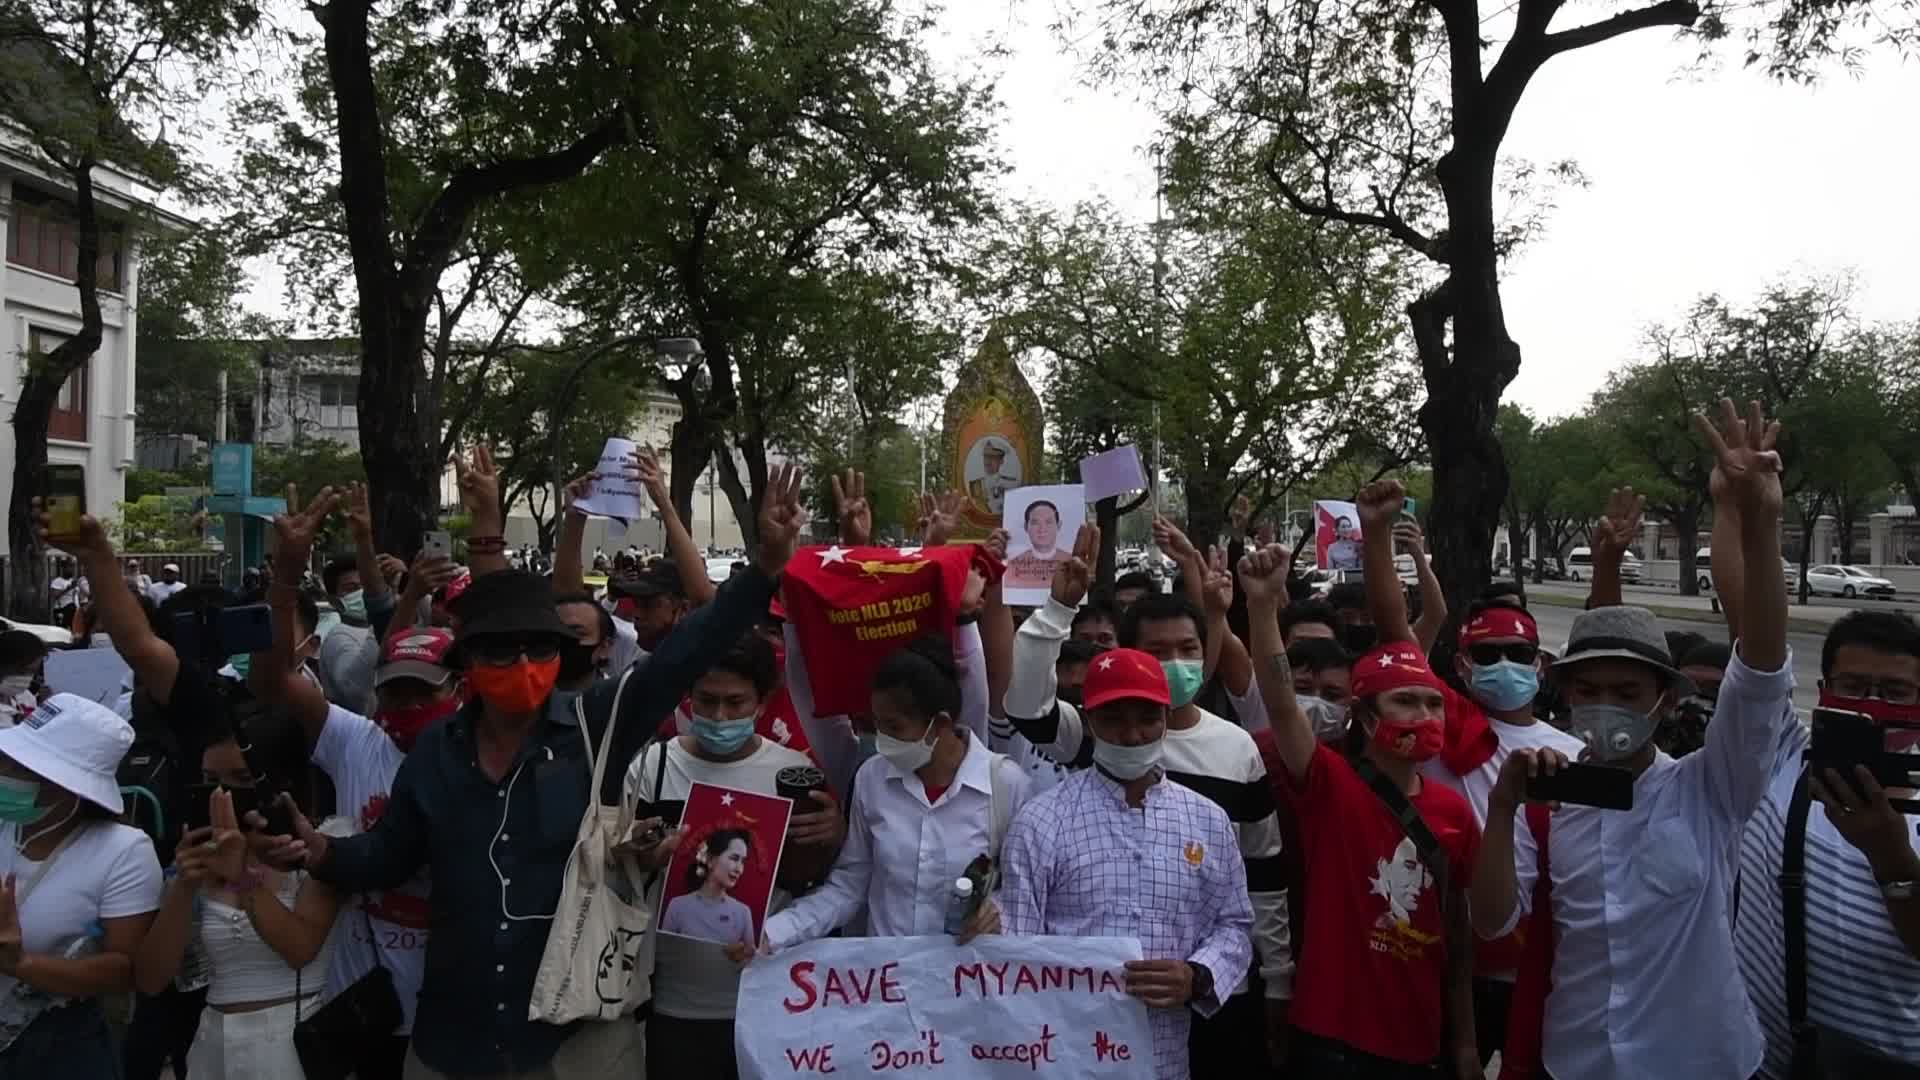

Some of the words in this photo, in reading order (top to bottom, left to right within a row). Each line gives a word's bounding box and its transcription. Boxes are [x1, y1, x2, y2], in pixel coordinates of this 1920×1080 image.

[828, 609, 860, 624] Vote
[861, 602, 890, 620] NLD
[893, 592, 931, 614] 2020
[856, 617, 917, 640] Election
[783, 961, 908, 1014] SAVE
[786, 1044, 836, 1074] WE
[971, 1024, 1057, 1070] accept
[1091, 1031, 1132, 1061] the
